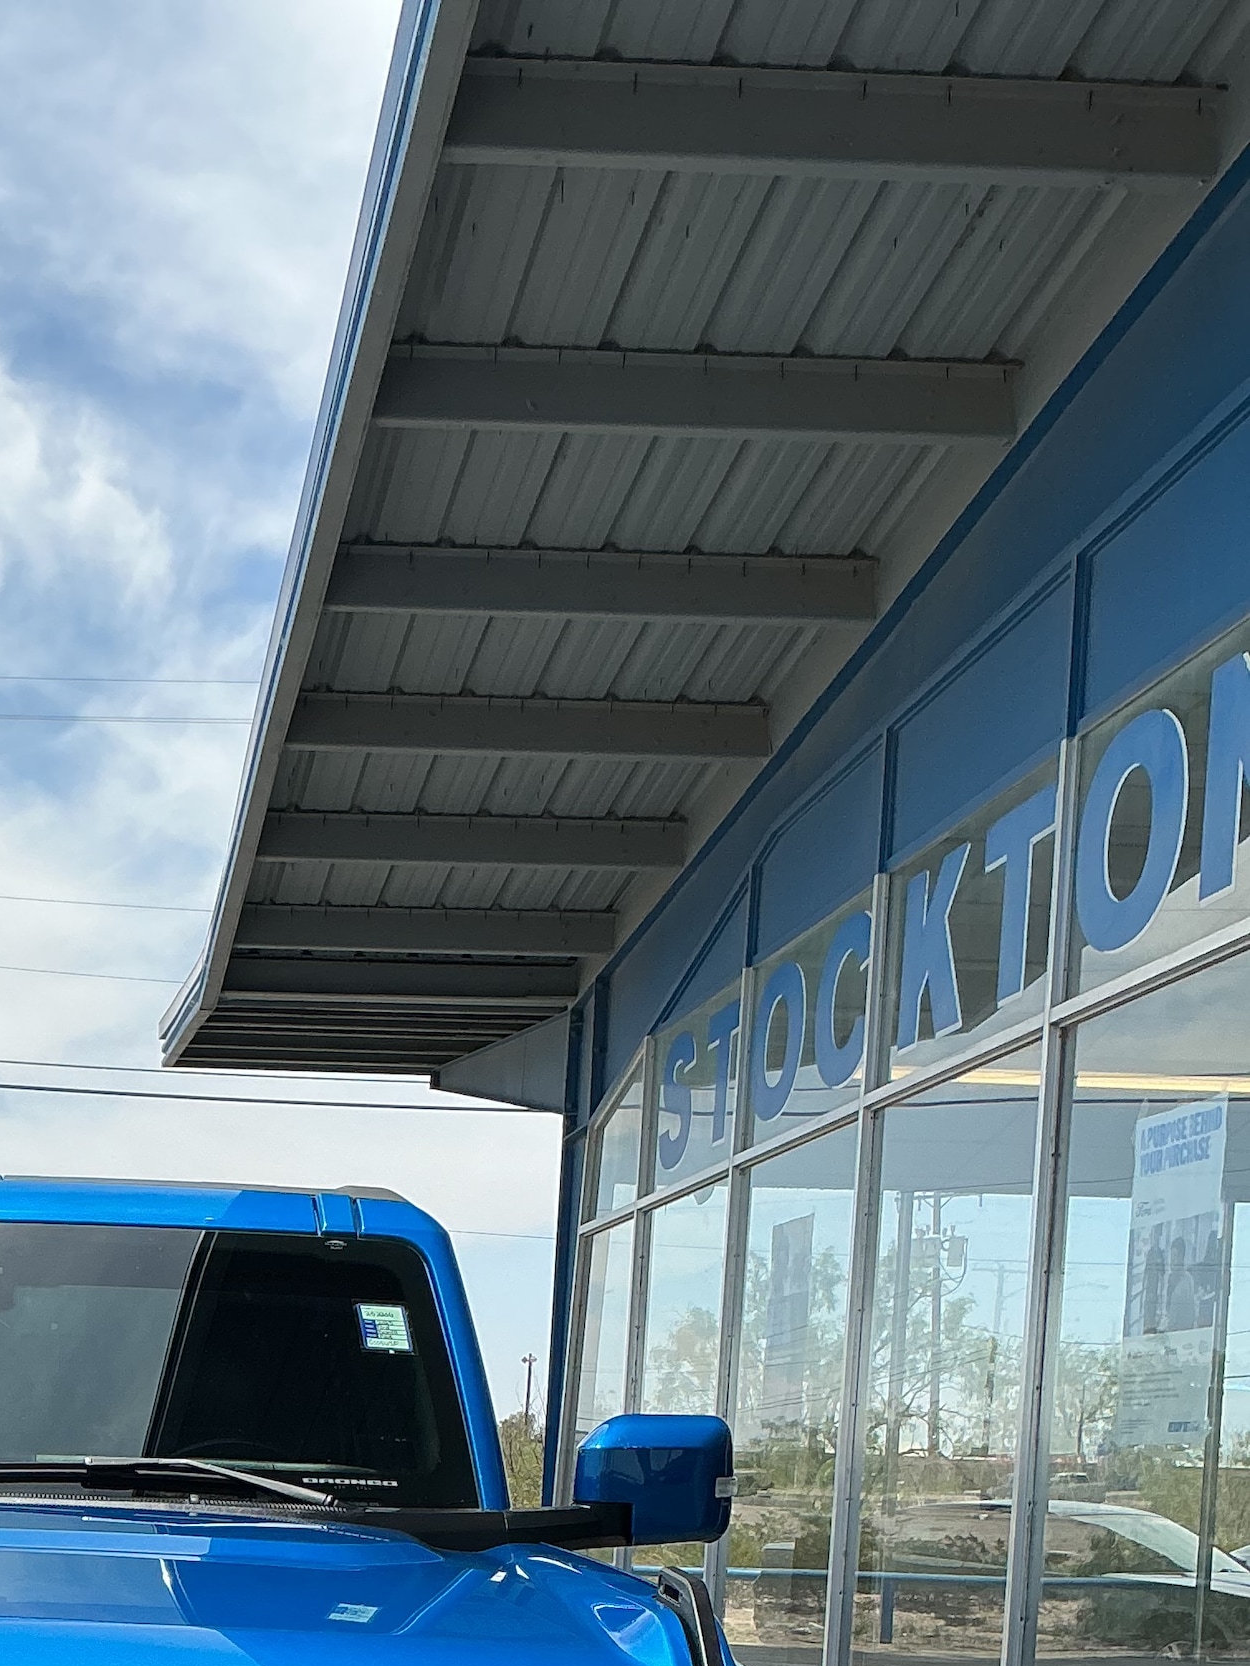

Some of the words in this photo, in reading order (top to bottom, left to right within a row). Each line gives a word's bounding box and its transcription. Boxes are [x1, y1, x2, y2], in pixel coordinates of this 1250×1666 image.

[1148, 1116, 1187, 1148] PURPOSE
[1189, 1106, 1222, 1136] BEHIND
[1140, 1149, 1163, 1177] YOUR
[1164, 1136, 1210, 1169] PURCHASE
